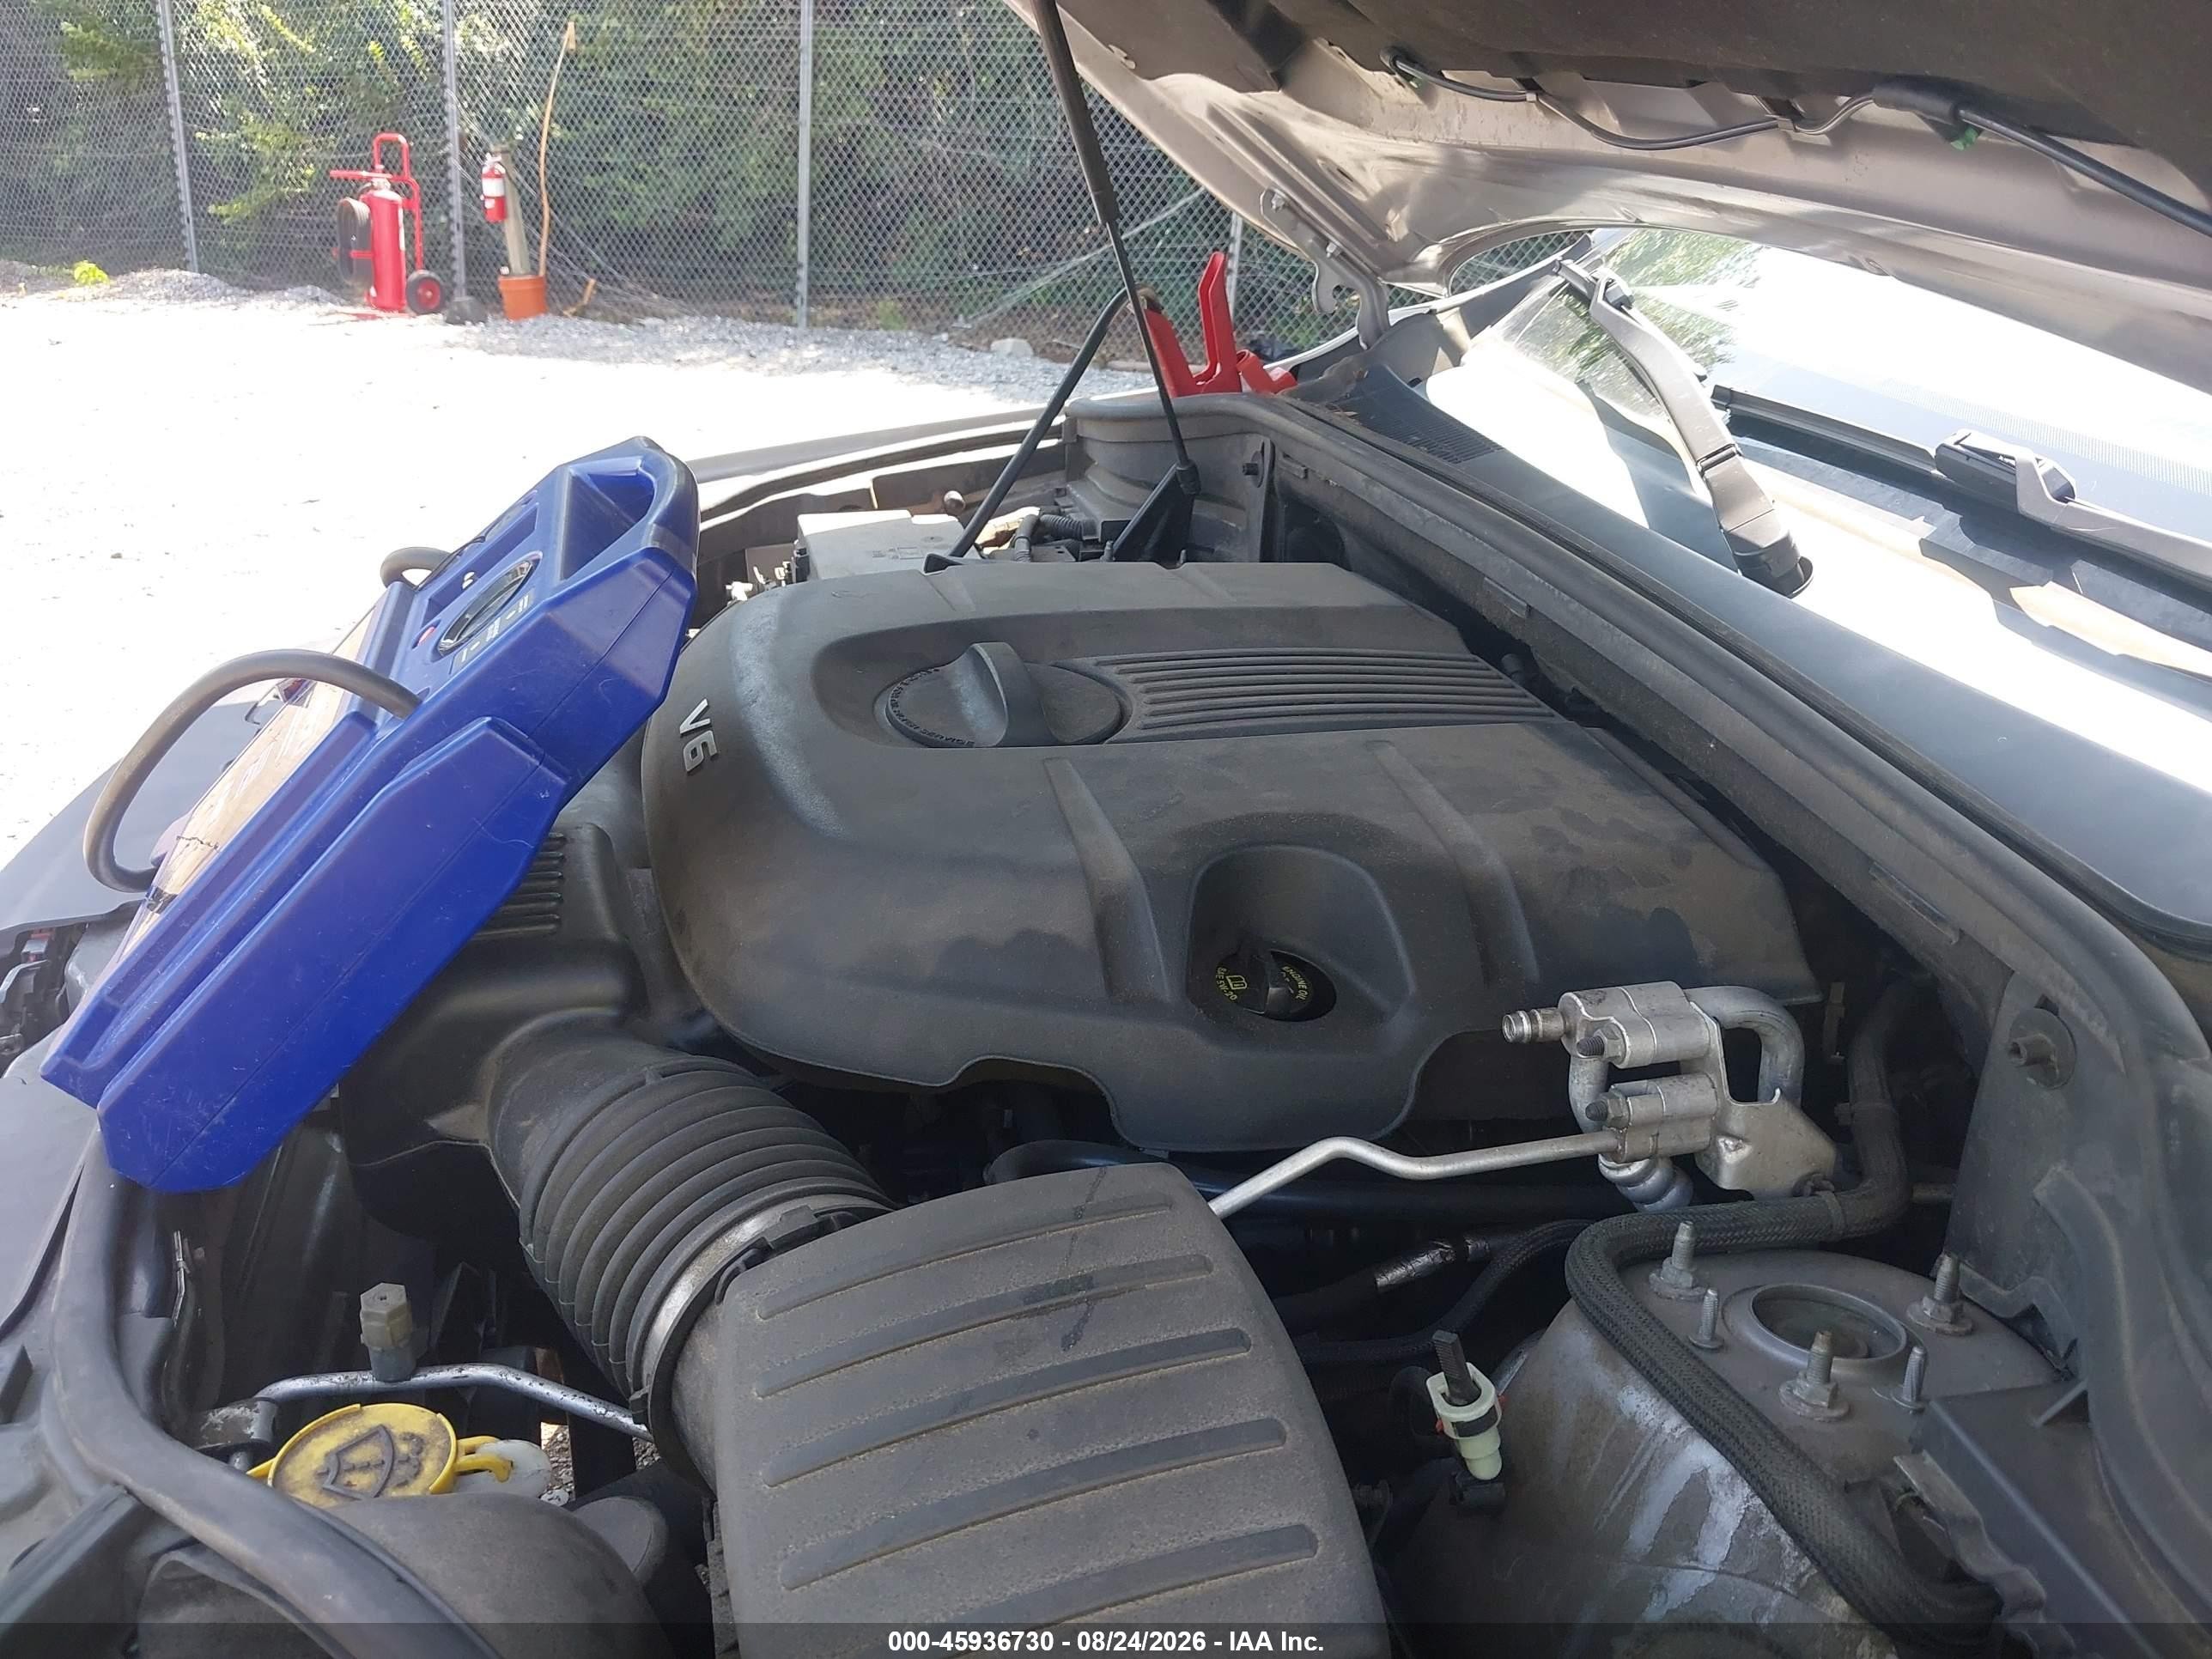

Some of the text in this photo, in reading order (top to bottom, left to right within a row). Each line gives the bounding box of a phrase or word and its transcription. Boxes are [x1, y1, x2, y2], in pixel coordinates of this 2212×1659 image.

[679, 698, 718, 772] V6
[1281, 965, 1310, 1000] ENGINE OIL
